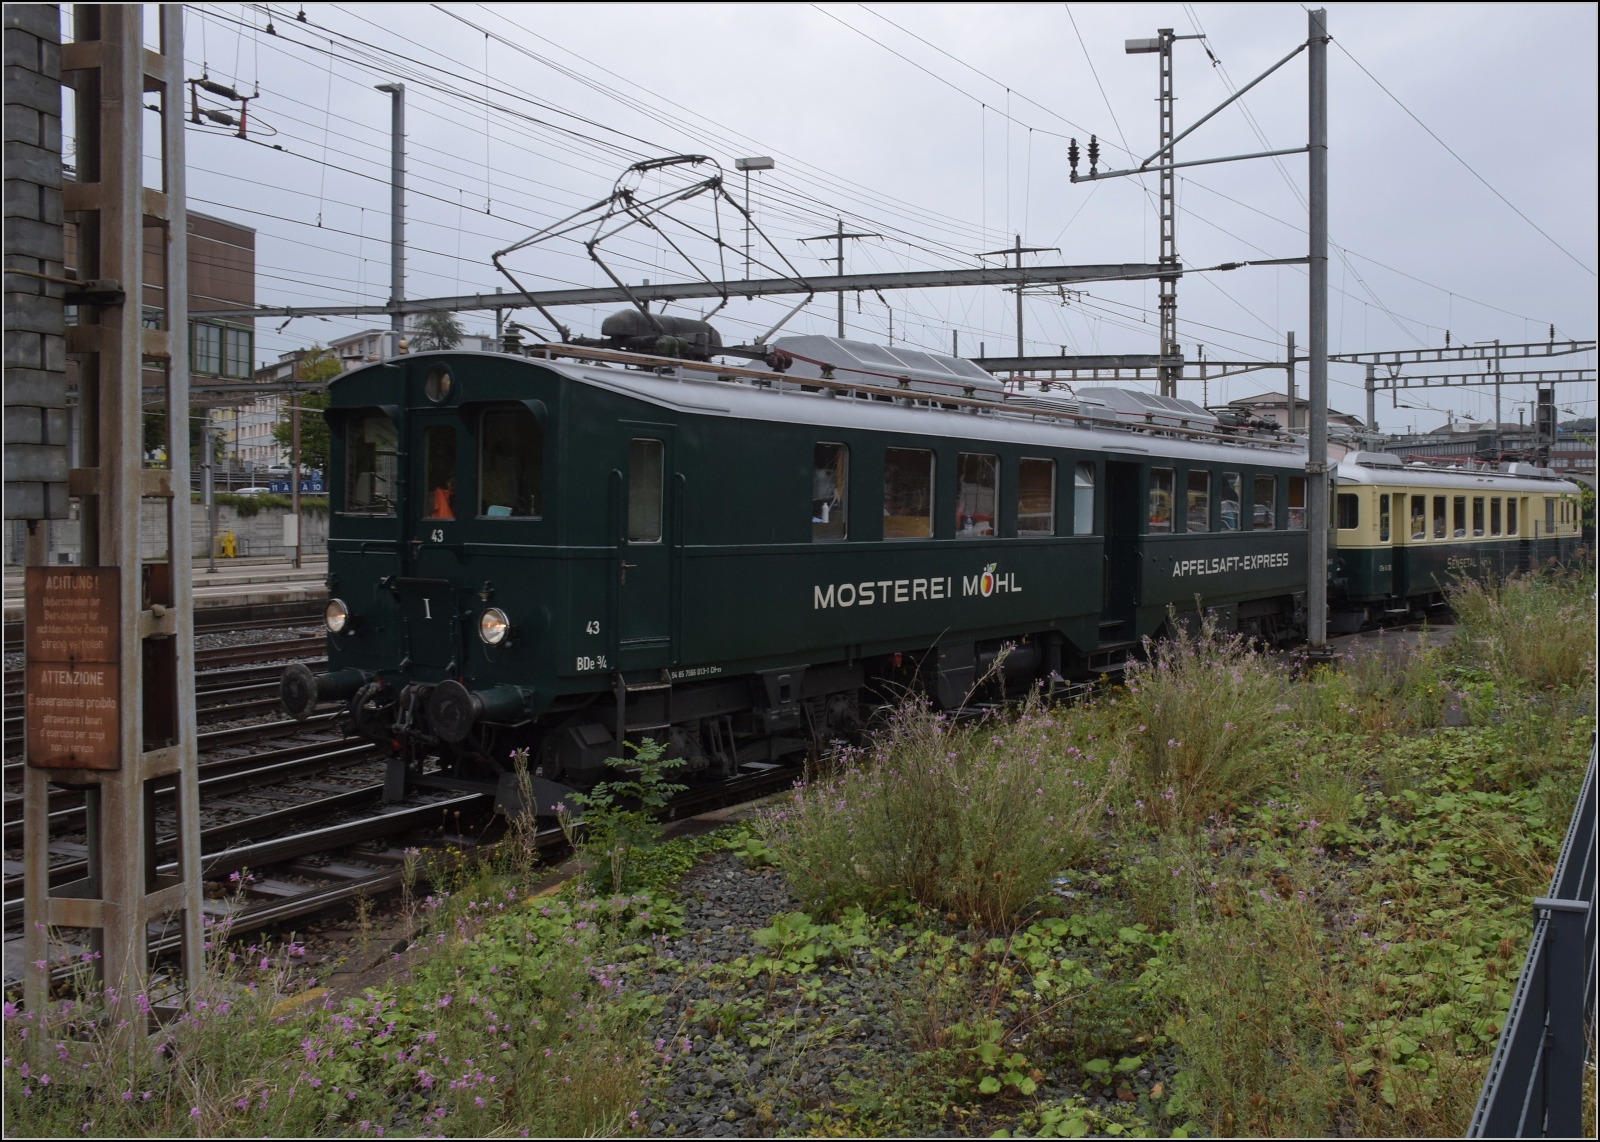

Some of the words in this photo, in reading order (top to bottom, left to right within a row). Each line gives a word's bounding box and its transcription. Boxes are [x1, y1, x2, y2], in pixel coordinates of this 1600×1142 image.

[302, 483, 309, 491] A
[312, 483, 321, 491] 10
[431, 529, 444, 543] 43
[1172, 552, 1290, 578] APFELSAFT-EXPRESS
[814, 576, 952, 610] MOSTEREI
[586, 620, 600, 635] 43
[41, 639, 67, 652] streng
[69, 638, 104, 649] verboten
[576, 656, 596, 671] BDe
[40, 670, 104, 686] ATTENZIONE
[36, 697, 85, 708] severamente
[86, 697, 116, 710] proibito
[43, 715, 80, 725] attraversare
[85, 715, 103, 725] binari
[75, 731, 87, 740] per
[88, 730, 106, 742] scopi
[70, 744, 94, 753] servizio
